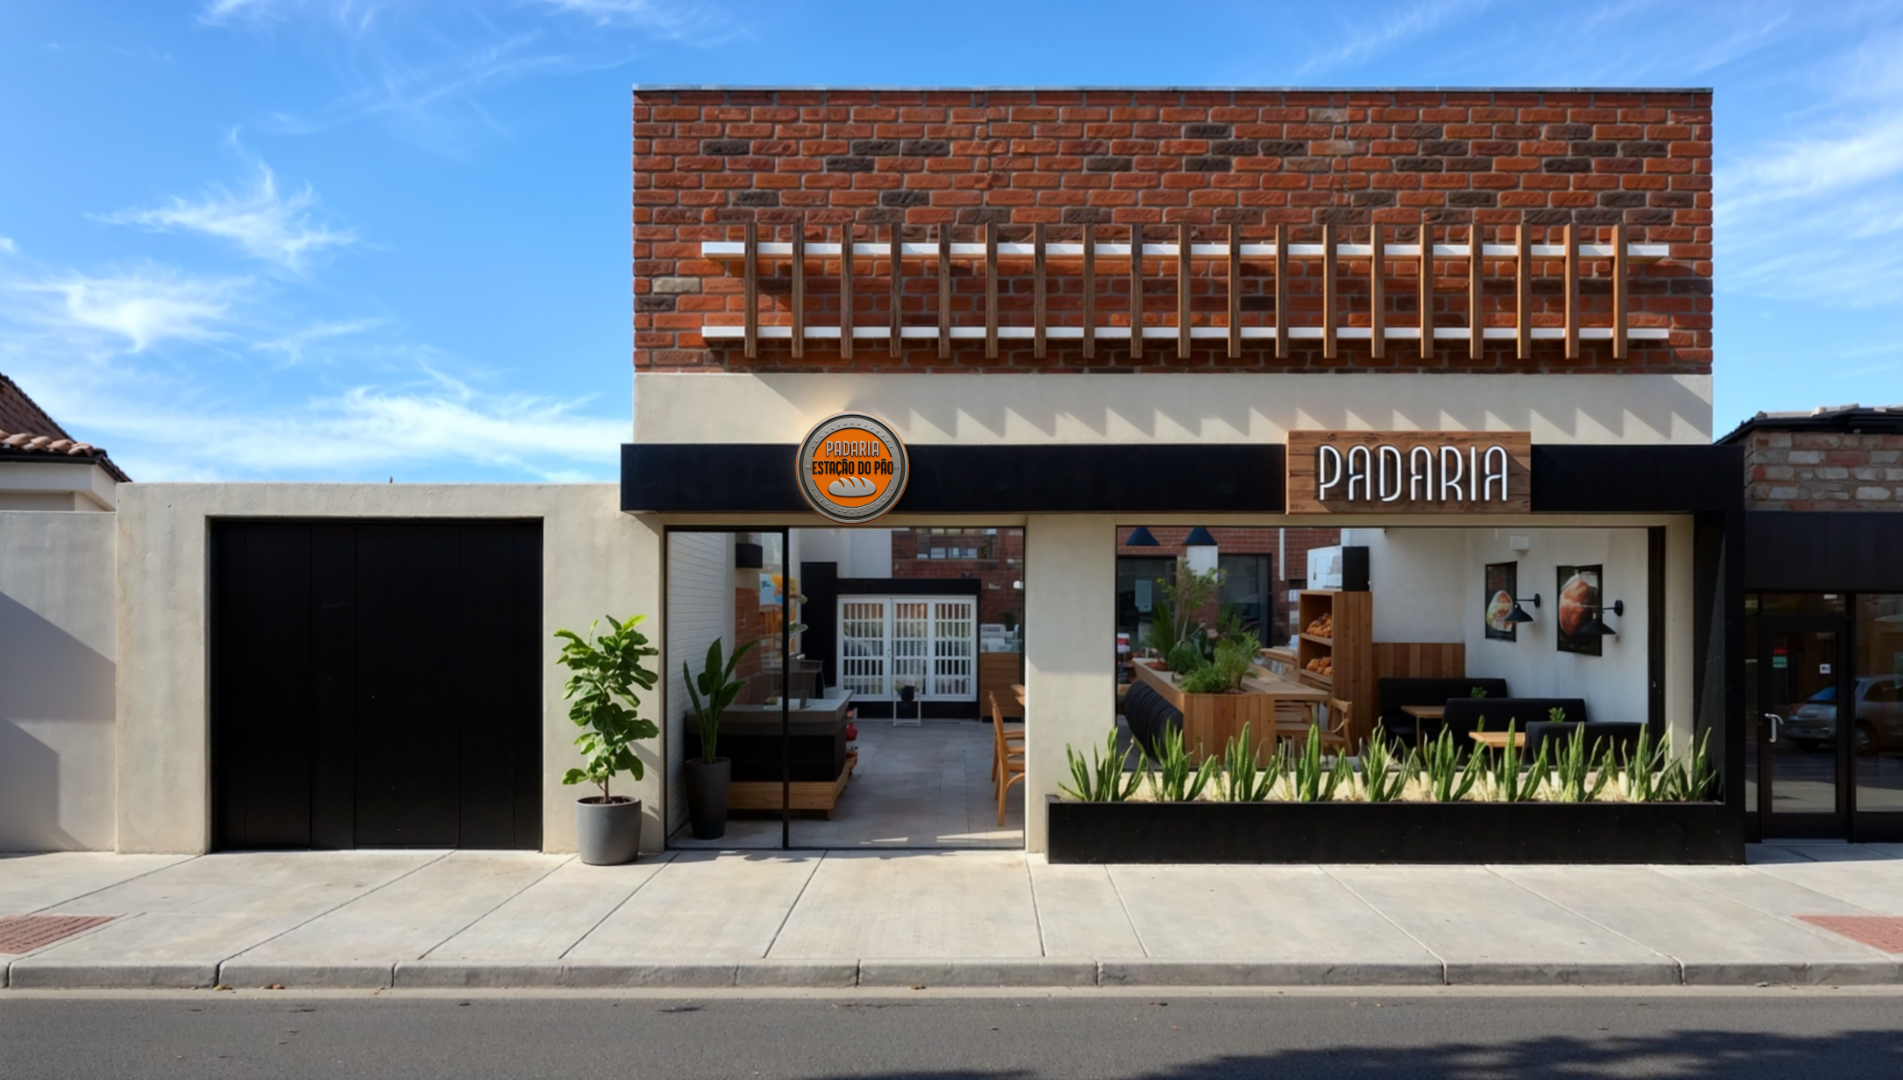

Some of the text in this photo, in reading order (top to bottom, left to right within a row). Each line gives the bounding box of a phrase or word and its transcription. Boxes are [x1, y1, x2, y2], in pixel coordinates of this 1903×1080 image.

[826, 441, 880, 457] PADARIA
[812, 459, 894, 476] ESTAÇÃO DO PÃO
[1319, 445, 1508, 502] PADARIA
